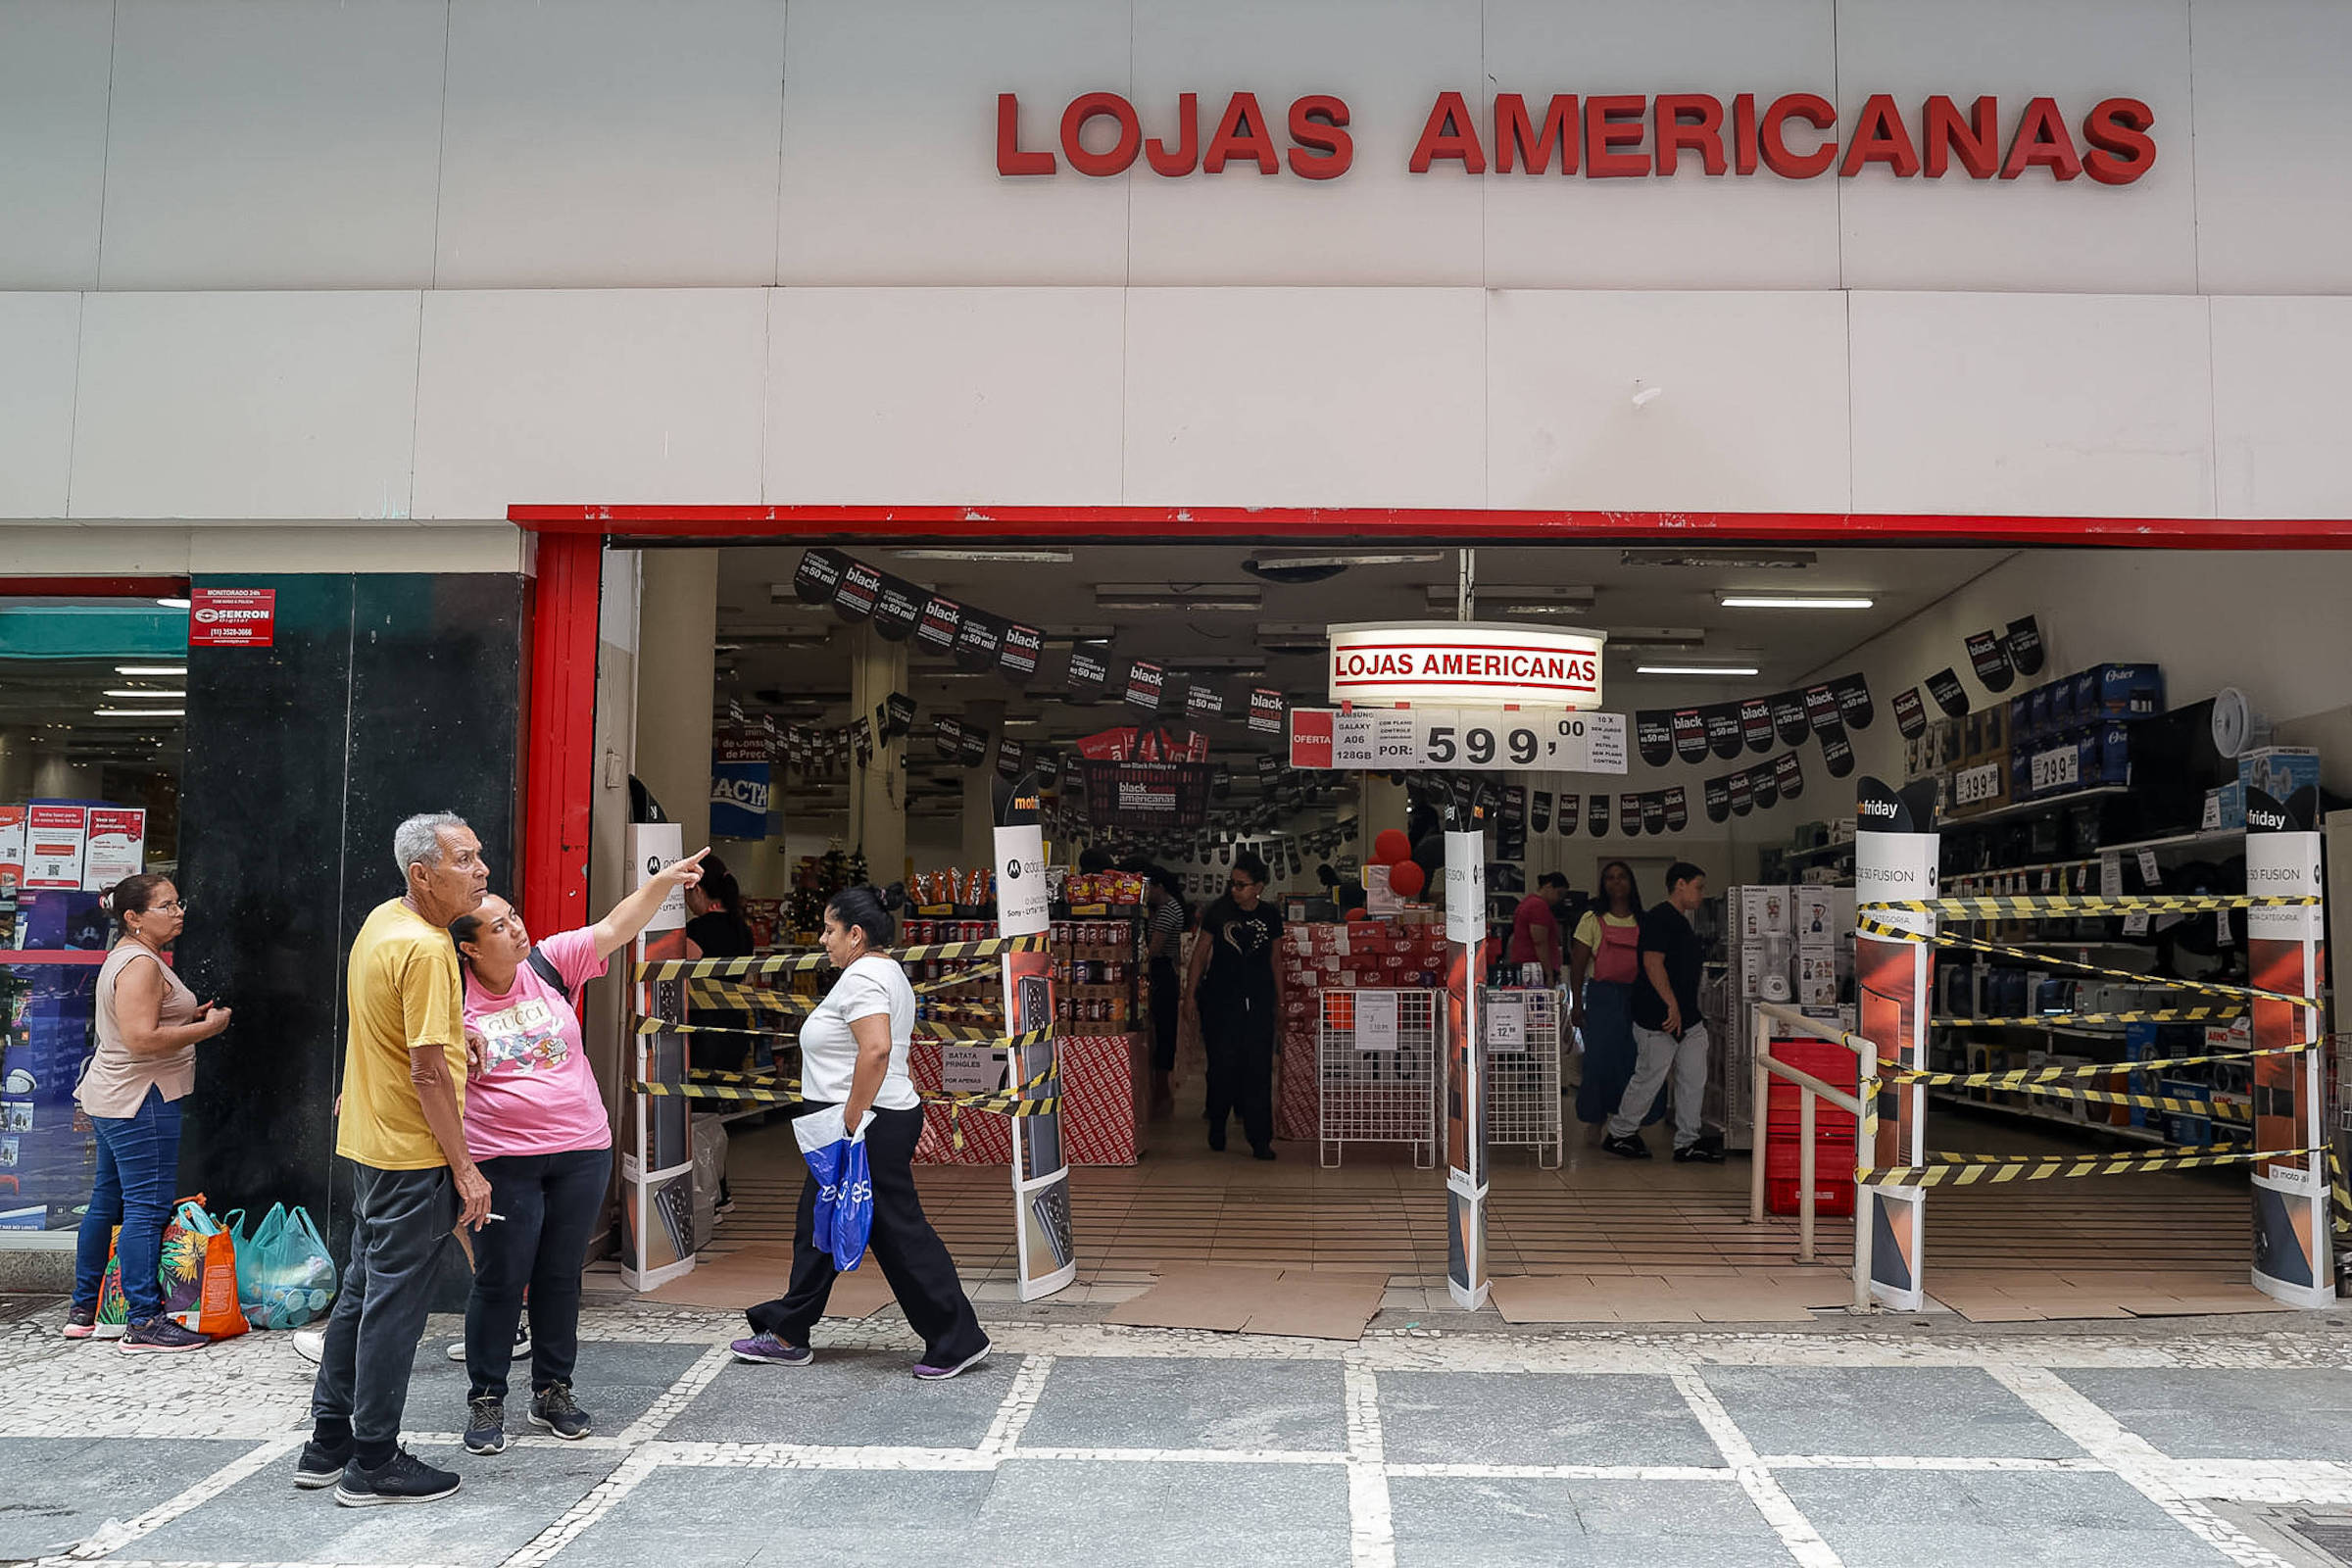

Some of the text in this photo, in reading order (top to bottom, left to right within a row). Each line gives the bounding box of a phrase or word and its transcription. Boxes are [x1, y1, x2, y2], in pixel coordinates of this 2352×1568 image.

[996, 90, 2157, 187] LOJAS AMERICANAS
[808, 566, 821, 578] 50
[821, 574, 836, 586] mil
[846, 566, 881, 592] black
[219, 610, 270, 619] SEKRON
[888, 604, 902, 614] 50
[900, 610, 916, 621] mil
[925, 601, 960, 624] black
[968, 633, 980, 645] 50
[981, 639, 996, 651] mil
[1005, 629, 1041, 651] black
[1969, 640, 1996, 657] black
[1078, 667, 1090, 677] 50
[1090, 671, 1104, 682] mil
[1130, 666, 1164, 686] black
[1336, 654, 1596, 681] LOJAS AMERICANAS
[2105, 668, 2134, 682] Oster
[1196, 699, 1207, 708] 50
[1207, 702, 1222, 711] mil
[1250, 694, 1284, 710] black
[1805, 690, 1835, 708] black
[1740, 704, 1770, 720] black
[1674, 715, 1703, 729] black
[1294, 734, 1331, 745] OFERTA
[2109, 731, 2128, 745] Ost
[1380, 746, 1413, 755] POR:
[712, 777, 767, 806] ACTA
[1119, 782, 1147, 793] black
[1119, 795, 1176, 804] americanas
[1864, 800, 1898, 818] friday
[2248, 809, 2285, 829] friday
[1874, 867, 1915, 883] FUSION
[2260, 868, 2300, 880] FUSION
[489, 1005, 543, 1030] GUCCI
